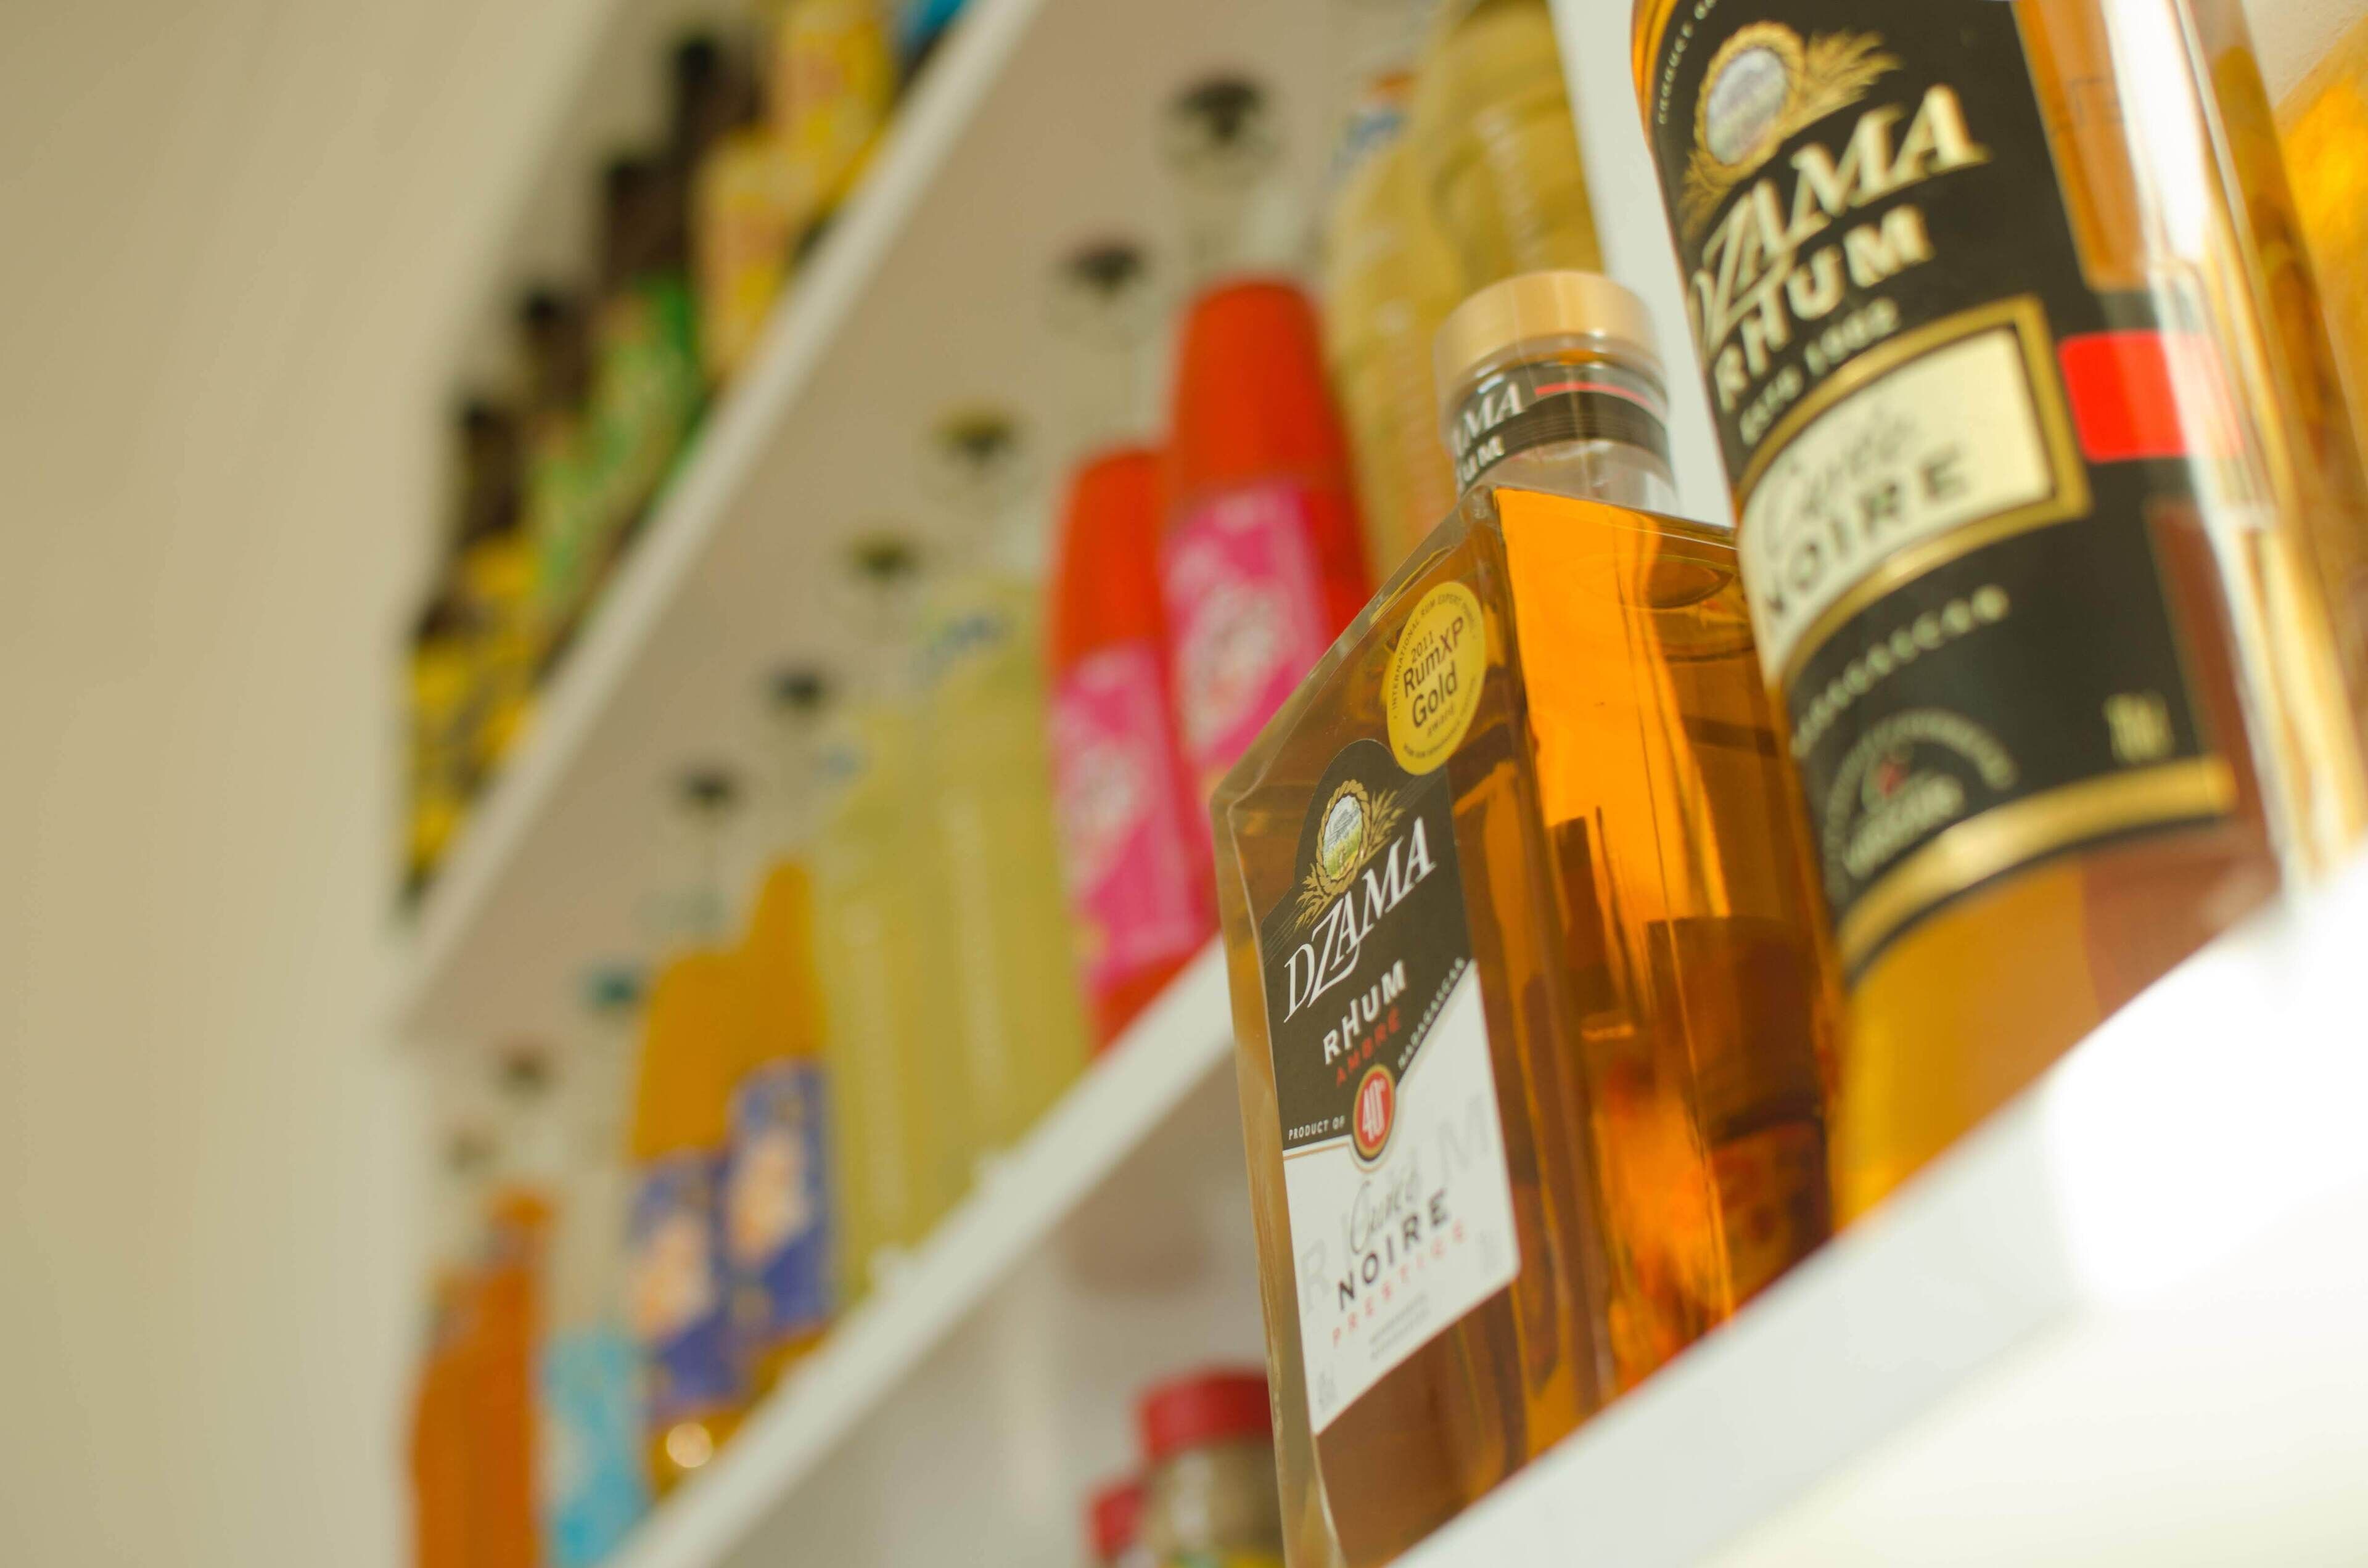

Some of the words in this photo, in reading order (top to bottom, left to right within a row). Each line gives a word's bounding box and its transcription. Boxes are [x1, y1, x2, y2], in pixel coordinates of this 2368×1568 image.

[1714, 203, 1935, 413] RHUM
[1403, 616, 1464, 698] RumXP
[1411, 630, 1434, 663] 2011
[1412, 659, 1458, 728] Gold
[1283, 815, 1437, 1024] DZAMA
[1323, 959, 1407, 1065] RHUM
[1288, 1119, 1329, 1141] PRODUCT
[1332, 1115, 1346, 1131] OF
[1337, 1188, 1449, 1311] NOIRE
